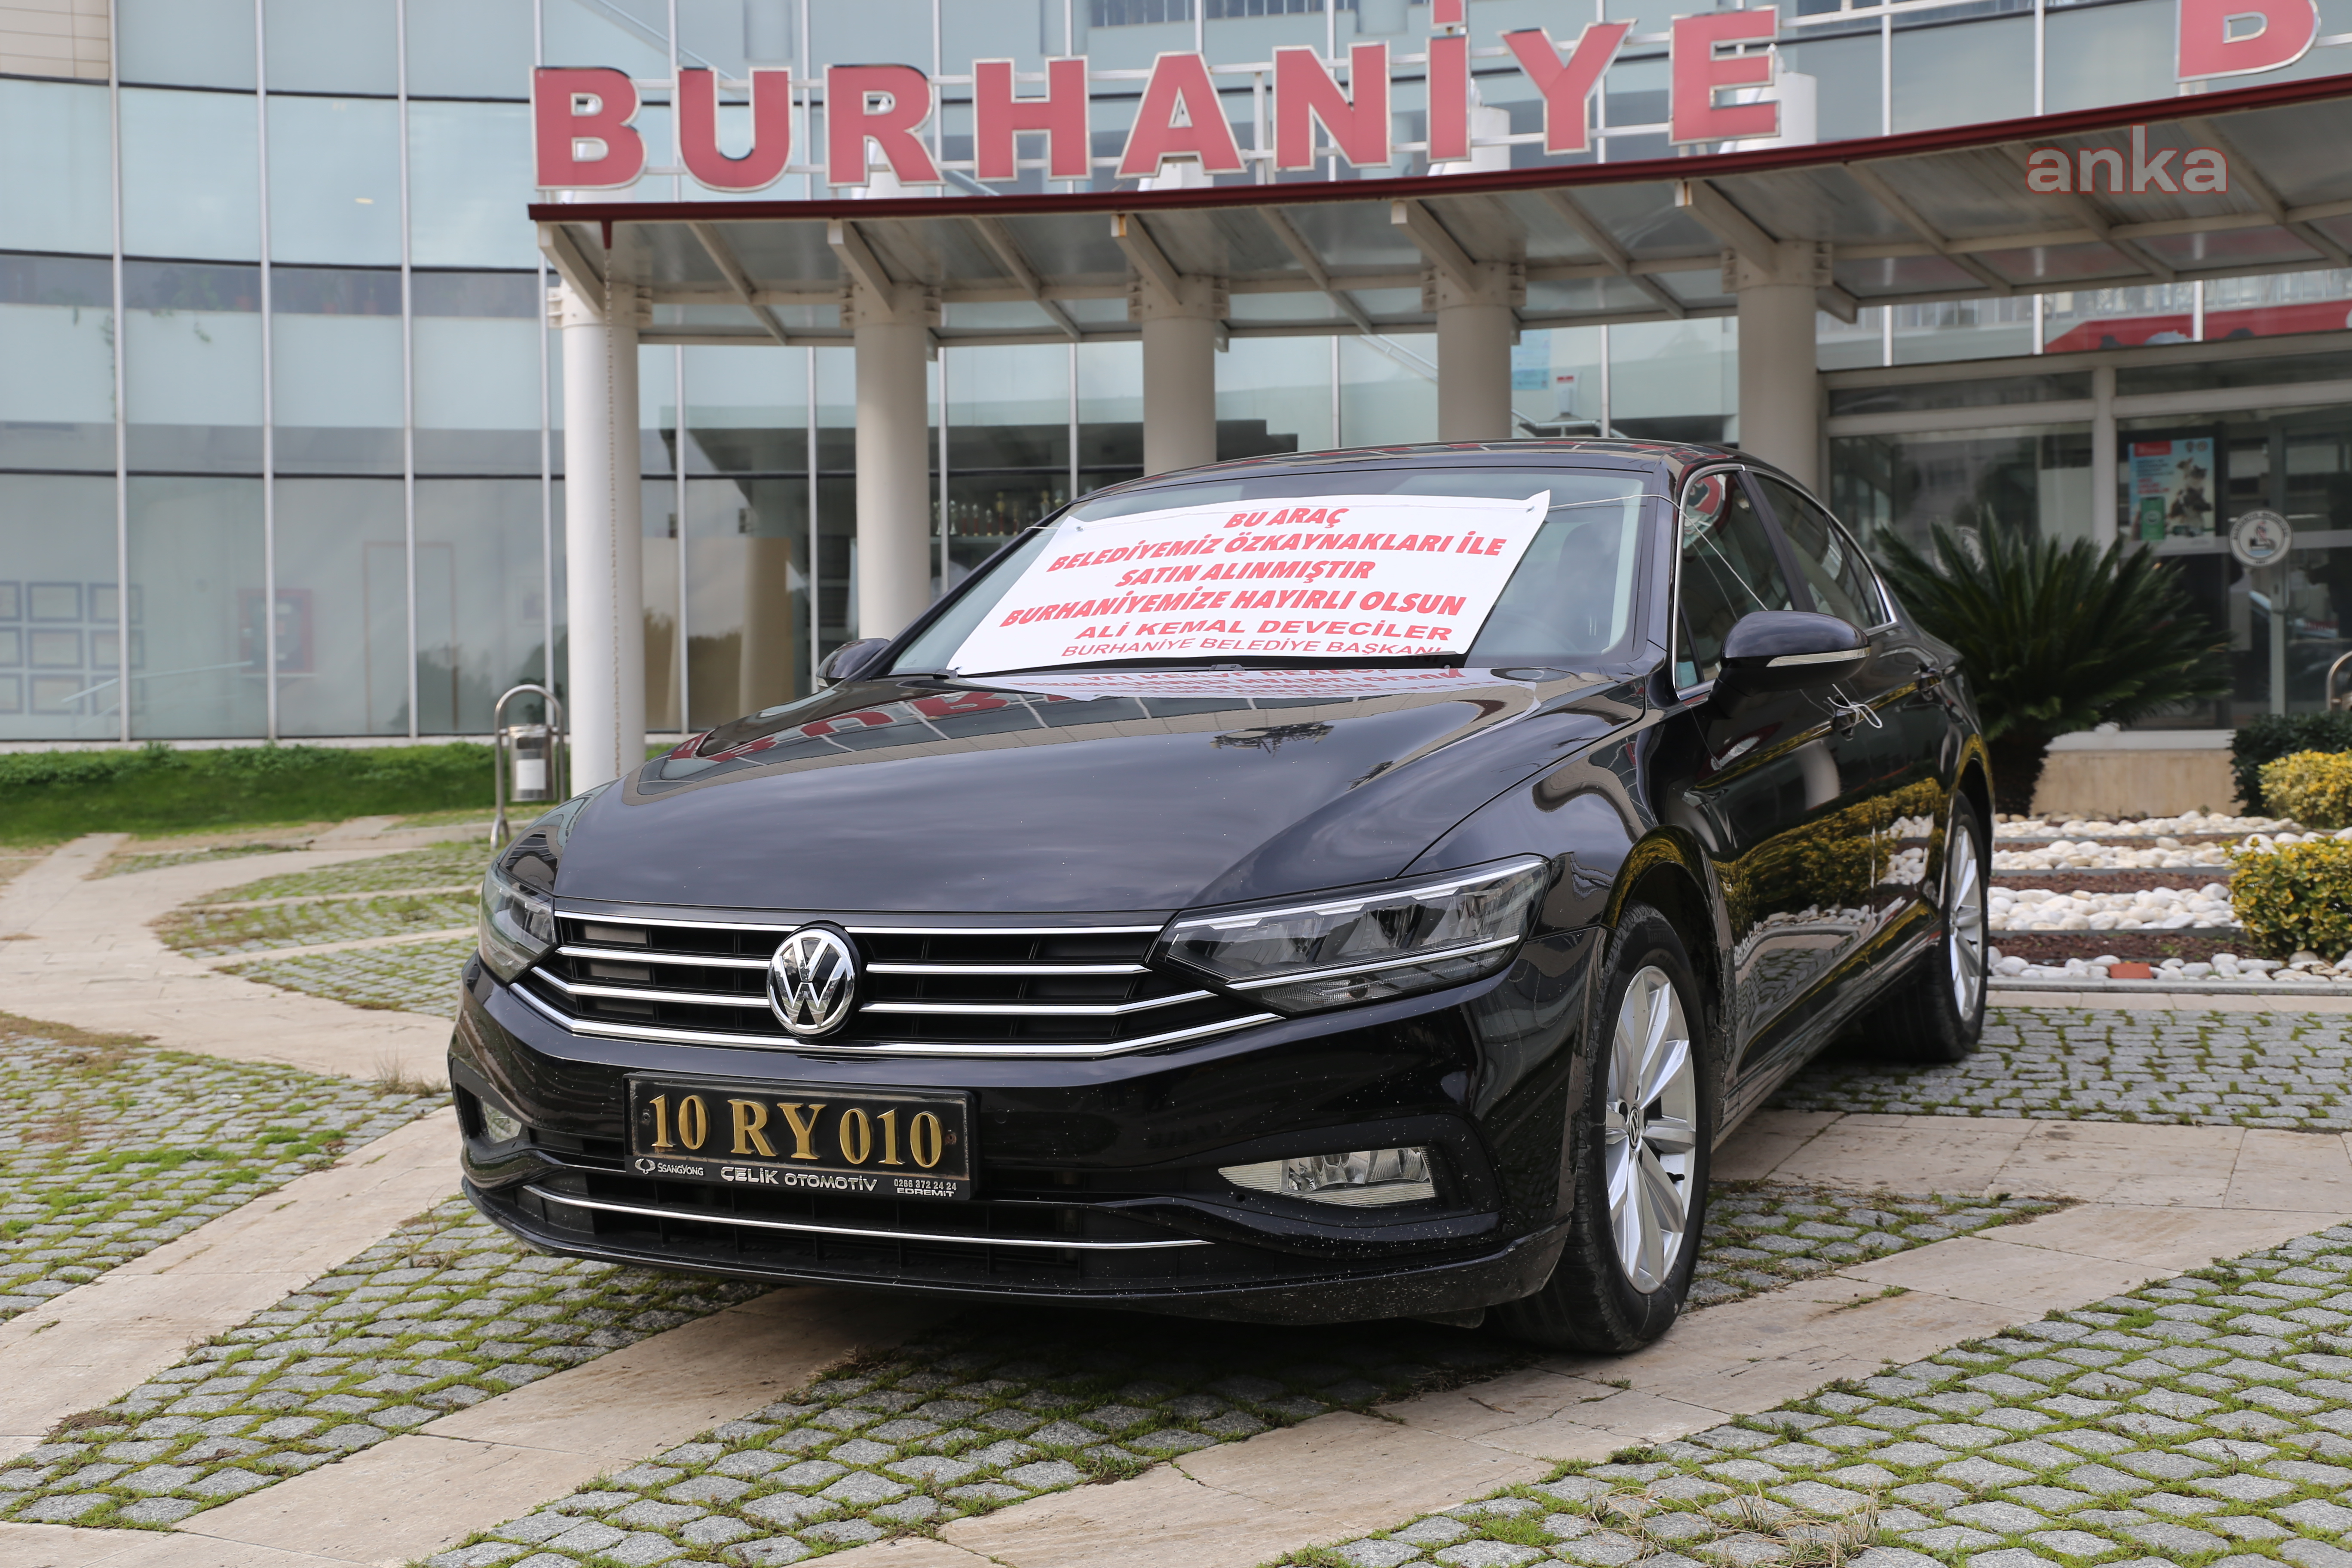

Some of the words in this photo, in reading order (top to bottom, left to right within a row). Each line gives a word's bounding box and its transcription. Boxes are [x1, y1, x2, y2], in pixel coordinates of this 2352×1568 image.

[530, 0, 1781, 192] BURHANİYE
[1224, 511, 1268, 528] BU
[1266, 508, 1350, 529] ARAÇ
[1047, 534, 1224, 572] BELEDİYEMİZ
[1225, 532, 1454, 553] ÖZKAYNAKLARI
[1456, 530, 1507, 556] İLE
[1115, 564, 1202, 587] SATIN
[1200, 560, 1376, 584] ALINMIŞTIR
[1000, 586, 1231, 627] BURHANİYEMİZE
[1230, 589, 1357, 609] HAYIRLI
[1359, 591, 1467, 616] OLSUN
[1075, 622, 1130, 639] ALİ
[1135, 620, 1245, 636] KEMAL
[1257, 620, 1452, 641] DEVECİLER
[1062, 638, 1195, 656] BURHANİYE
[1200, 637, 1322, 651] BELEDİYE
[649, 1094, 710, 1150] 10
[727, 1099, 827, 1160] RY
[839, 1108, 943, 1168] 010
[894, 1179, 913, 1188] 0266
[916, 1179, 931, 1189] 372
[933, 1181, 944, 1190] 24
[946, 1182, 957, 1191] 24
